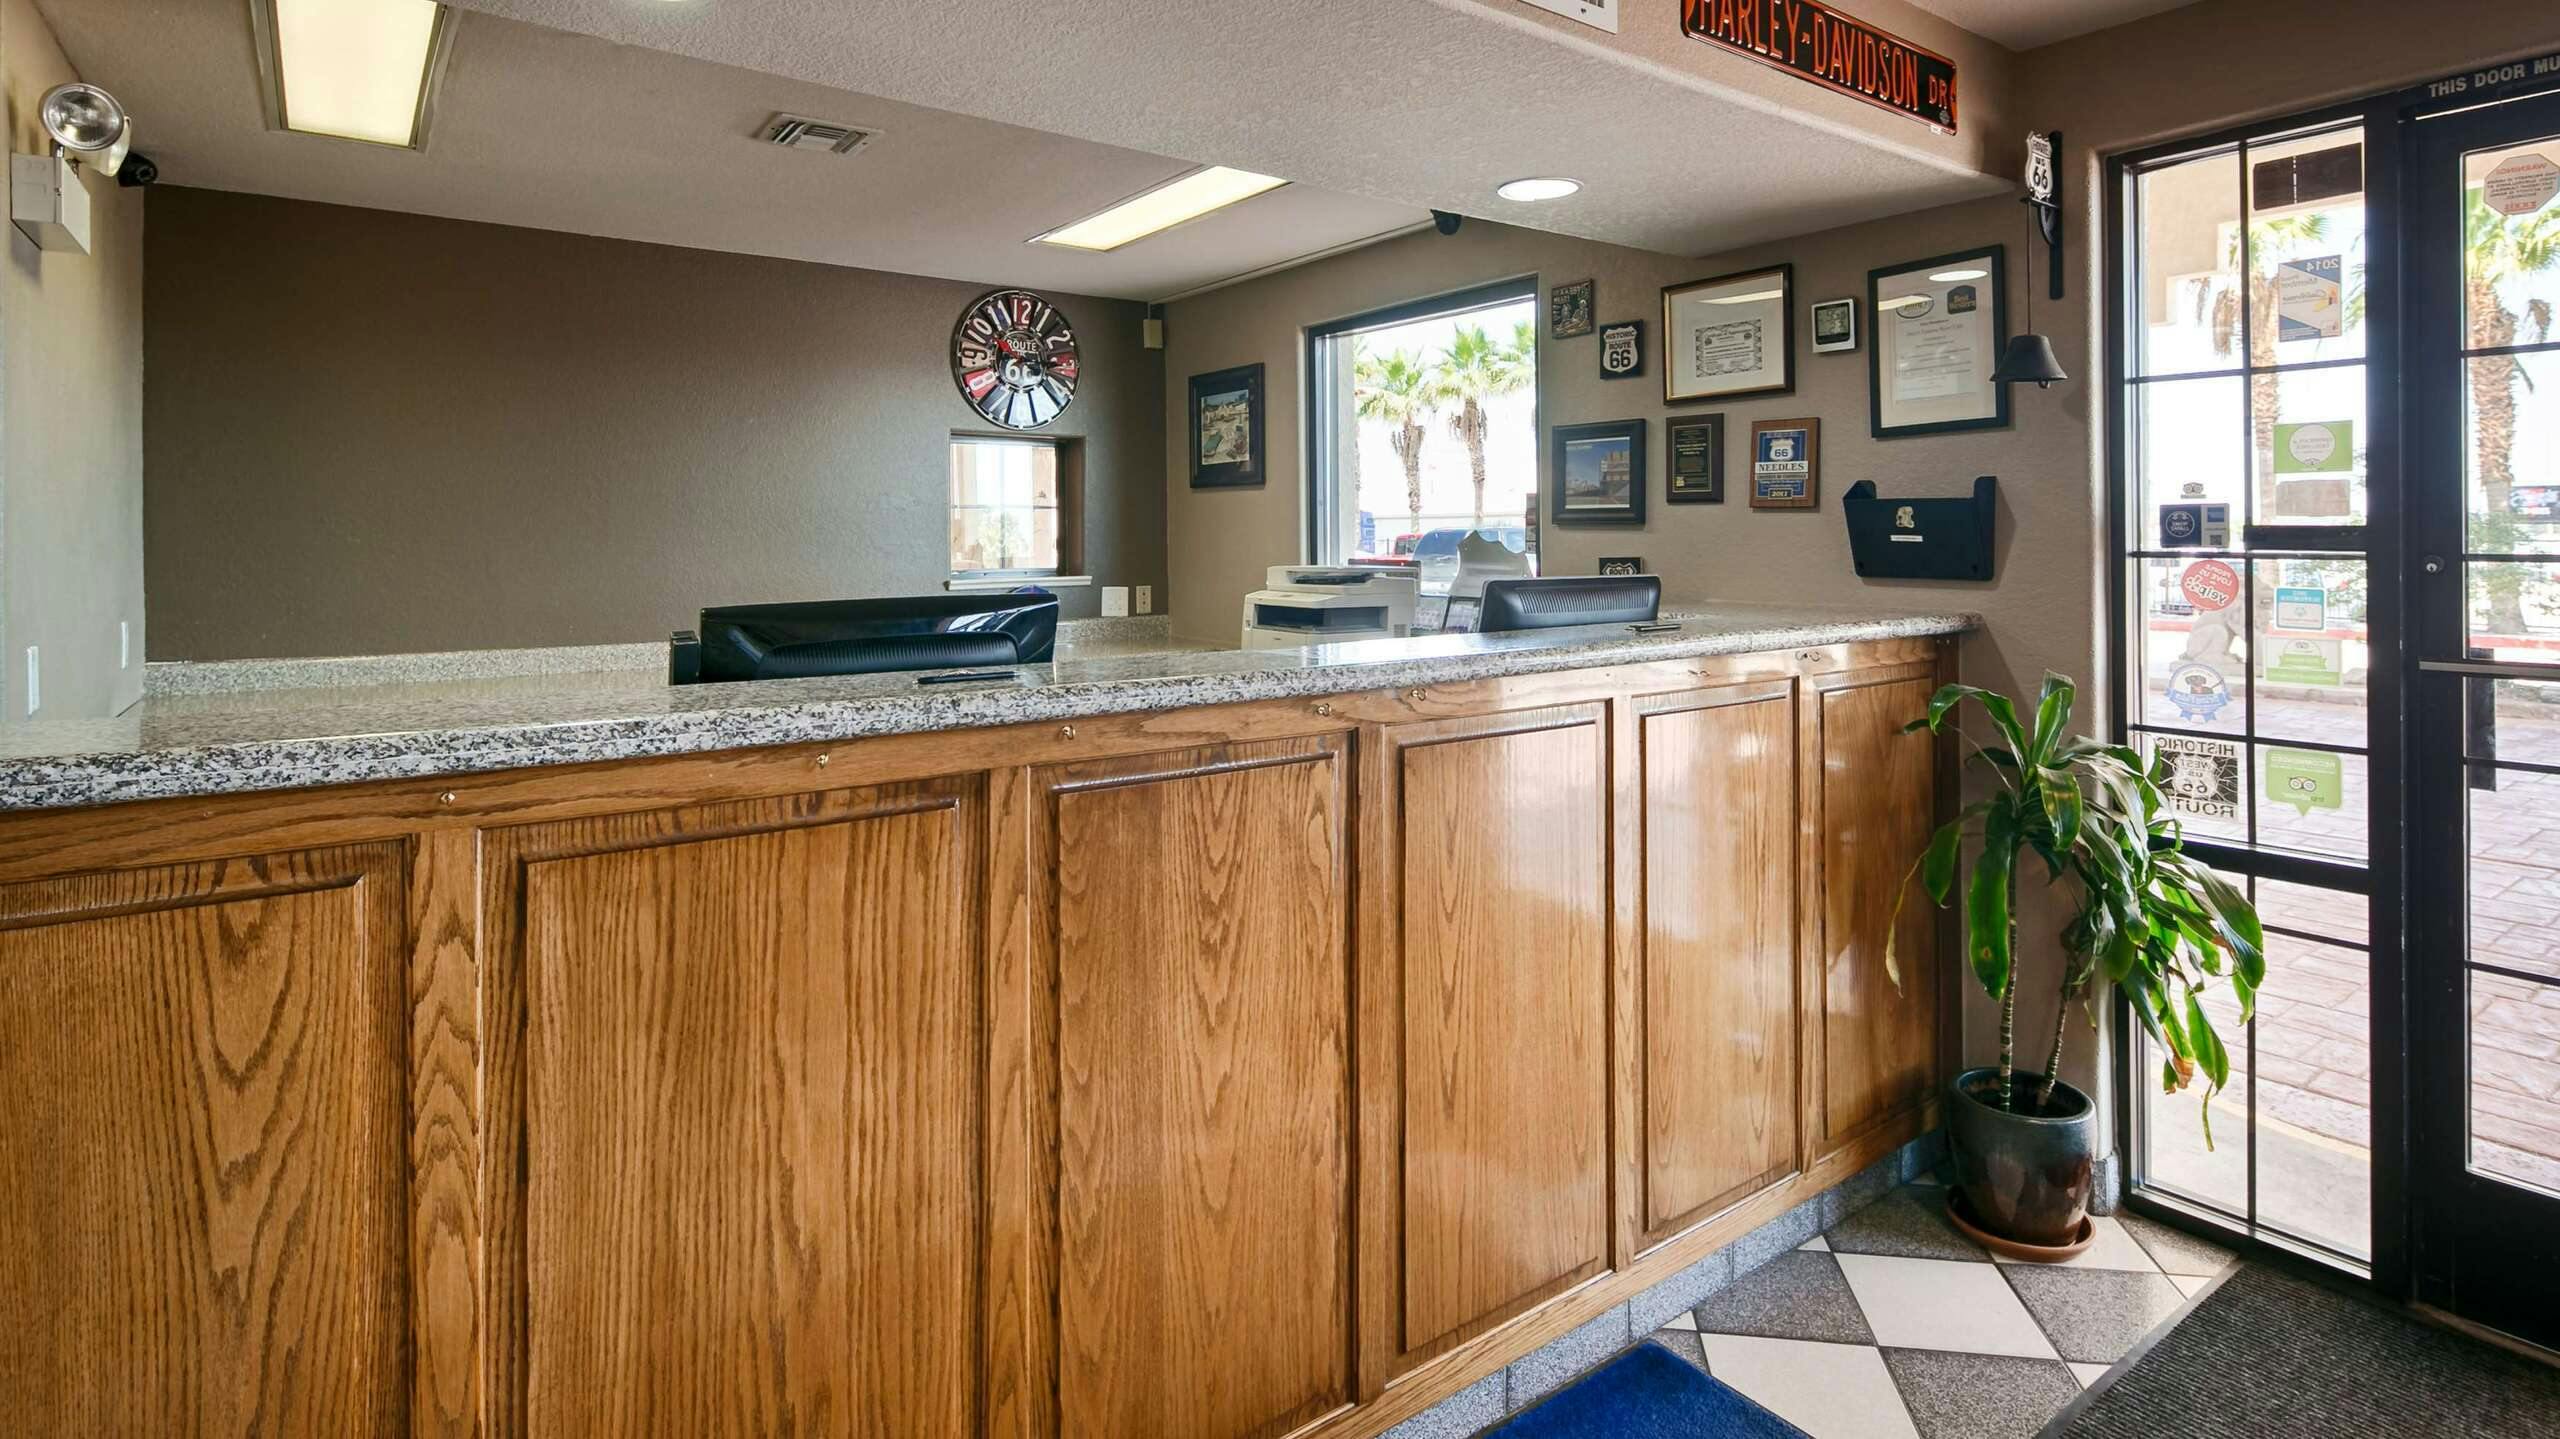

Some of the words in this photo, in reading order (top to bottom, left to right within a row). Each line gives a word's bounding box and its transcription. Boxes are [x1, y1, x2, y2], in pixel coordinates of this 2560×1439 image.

[2428, 77, 2468, 98] THIS
[2474, 63, 2526, 88] DOOR
[1928, 74, 1948, 110] DR
[2033, 166, 2049, 190] 66
[987, 300, 1012, 332] 11
[1012, 299, 1032, 325] 12
[967, 318, 993, 344] 10
[1046, 329, 1071, 350] 2
[1605, 331, 1634, 340] HISTORIC
[963, 346, 989, 361] 9
[1006, 339, 1037, 352] ROUTE
[1608, 341, 1632, 351] ROUTE
[1610, 350, 1631, 369] 66
[968, 370, 996, 392] 8
[1774, 448, 1789, 458] 66
[1759, 462, 1805, 473] NEEDLES
